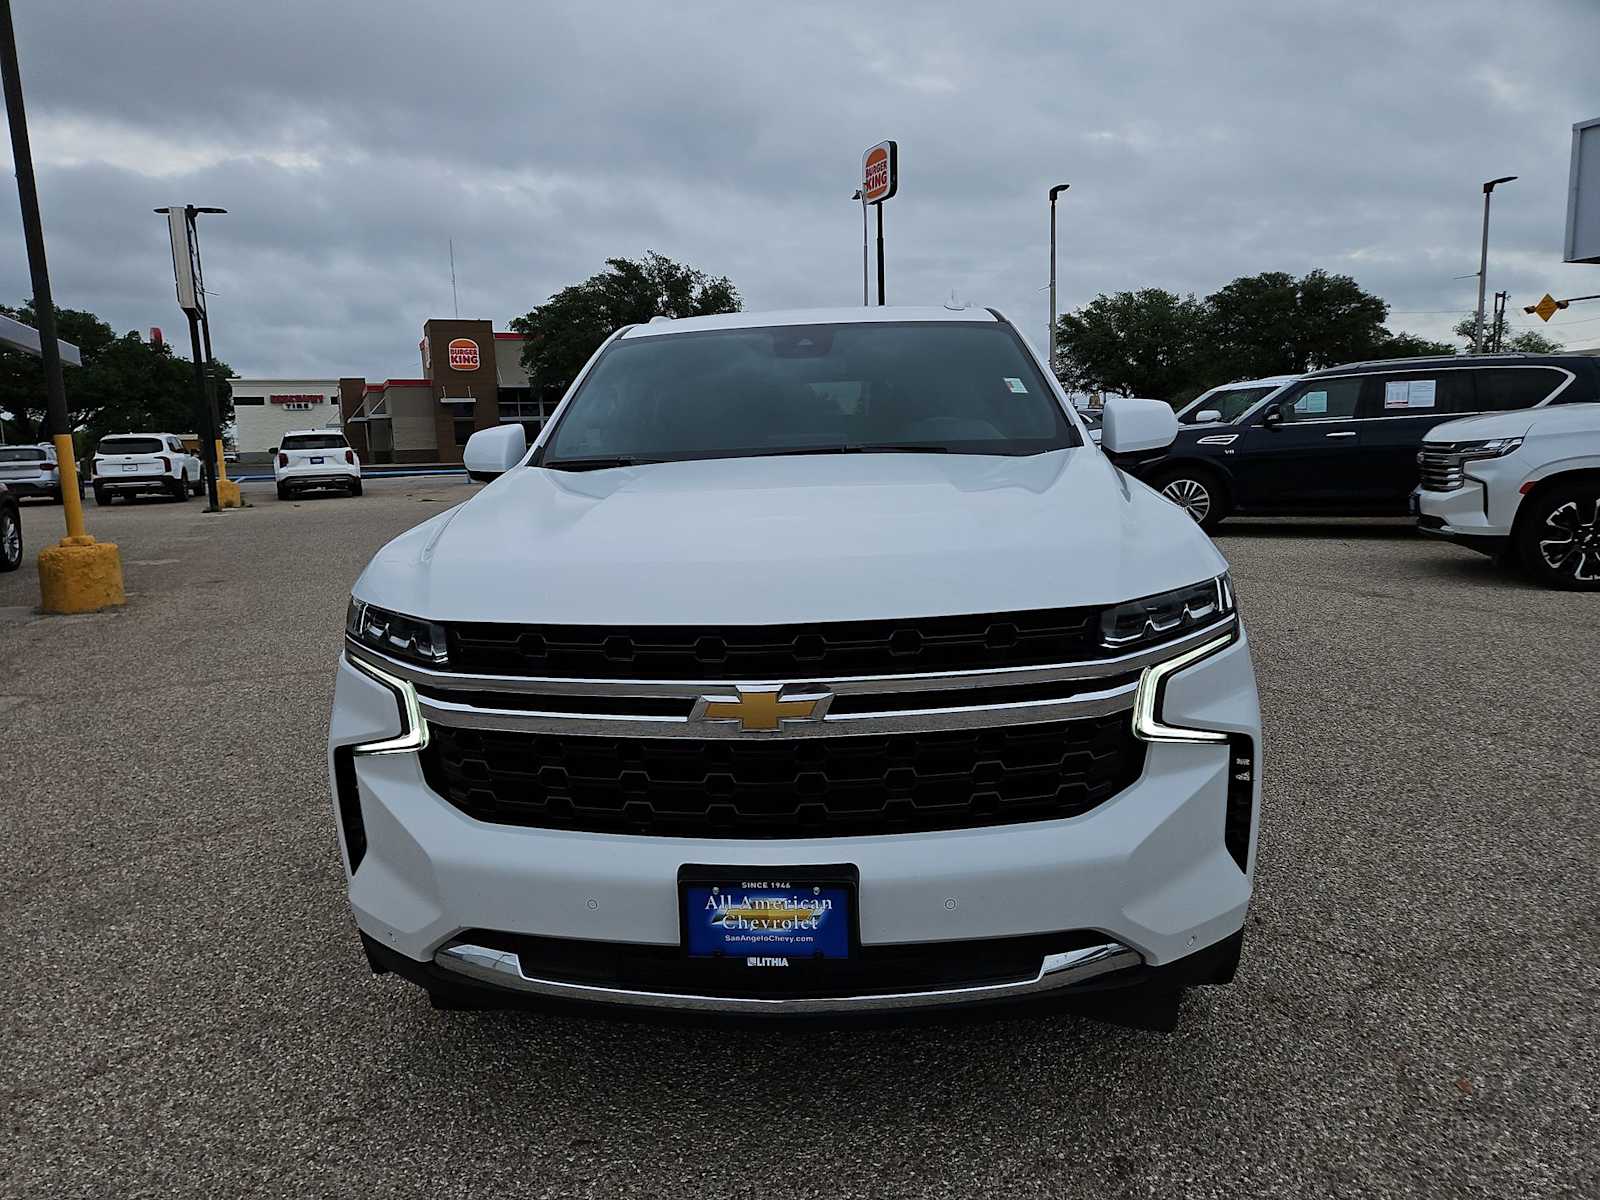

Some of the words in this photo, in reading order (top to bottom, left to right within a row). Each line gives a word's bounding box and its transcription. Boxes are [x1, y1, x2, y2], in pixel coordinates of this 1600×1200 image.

[865, 160, 888, 178] BURGER
[865, 171, 888, 192] KING
[451, 355, 479, 364] KING
[704, 895, 732, 910] All
[739, 895, 833, 910] American
[722, 915, 818, 930] Chevrolet
[725, 935, 814, 943] SanAngeloChevy.com
[756, 957, 789, 967] LITHIA
